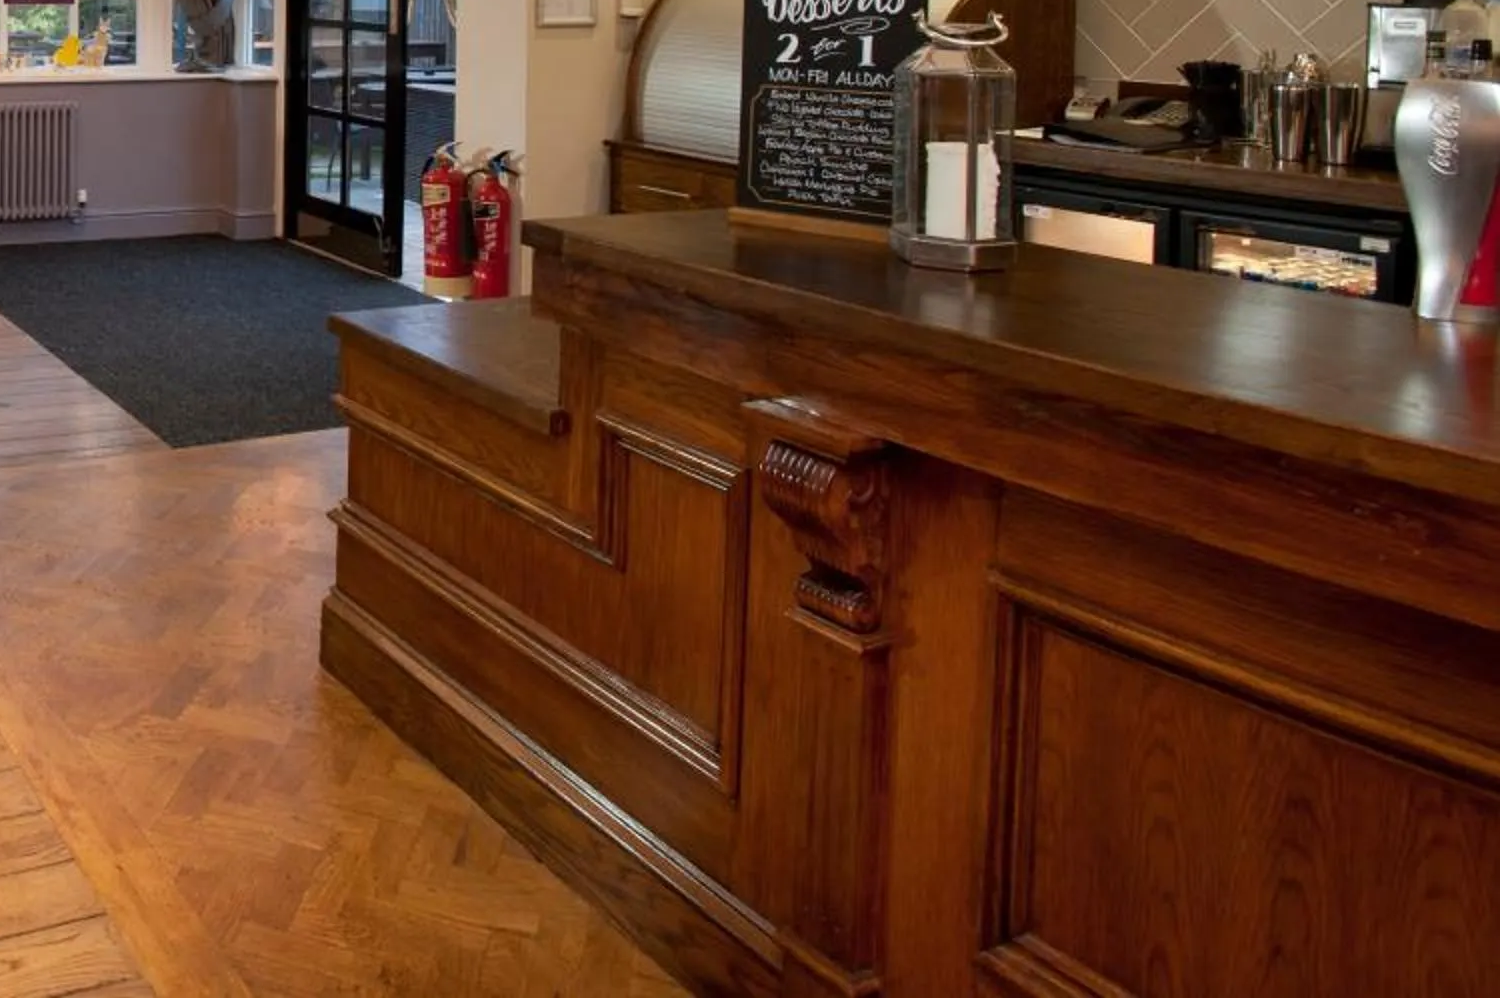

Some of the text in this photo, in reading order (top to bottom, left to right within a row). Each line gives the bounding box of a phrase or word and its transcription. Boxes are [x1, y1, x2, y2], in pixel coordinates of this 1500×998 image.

[775, 33, 877, 67] 2 for 1
